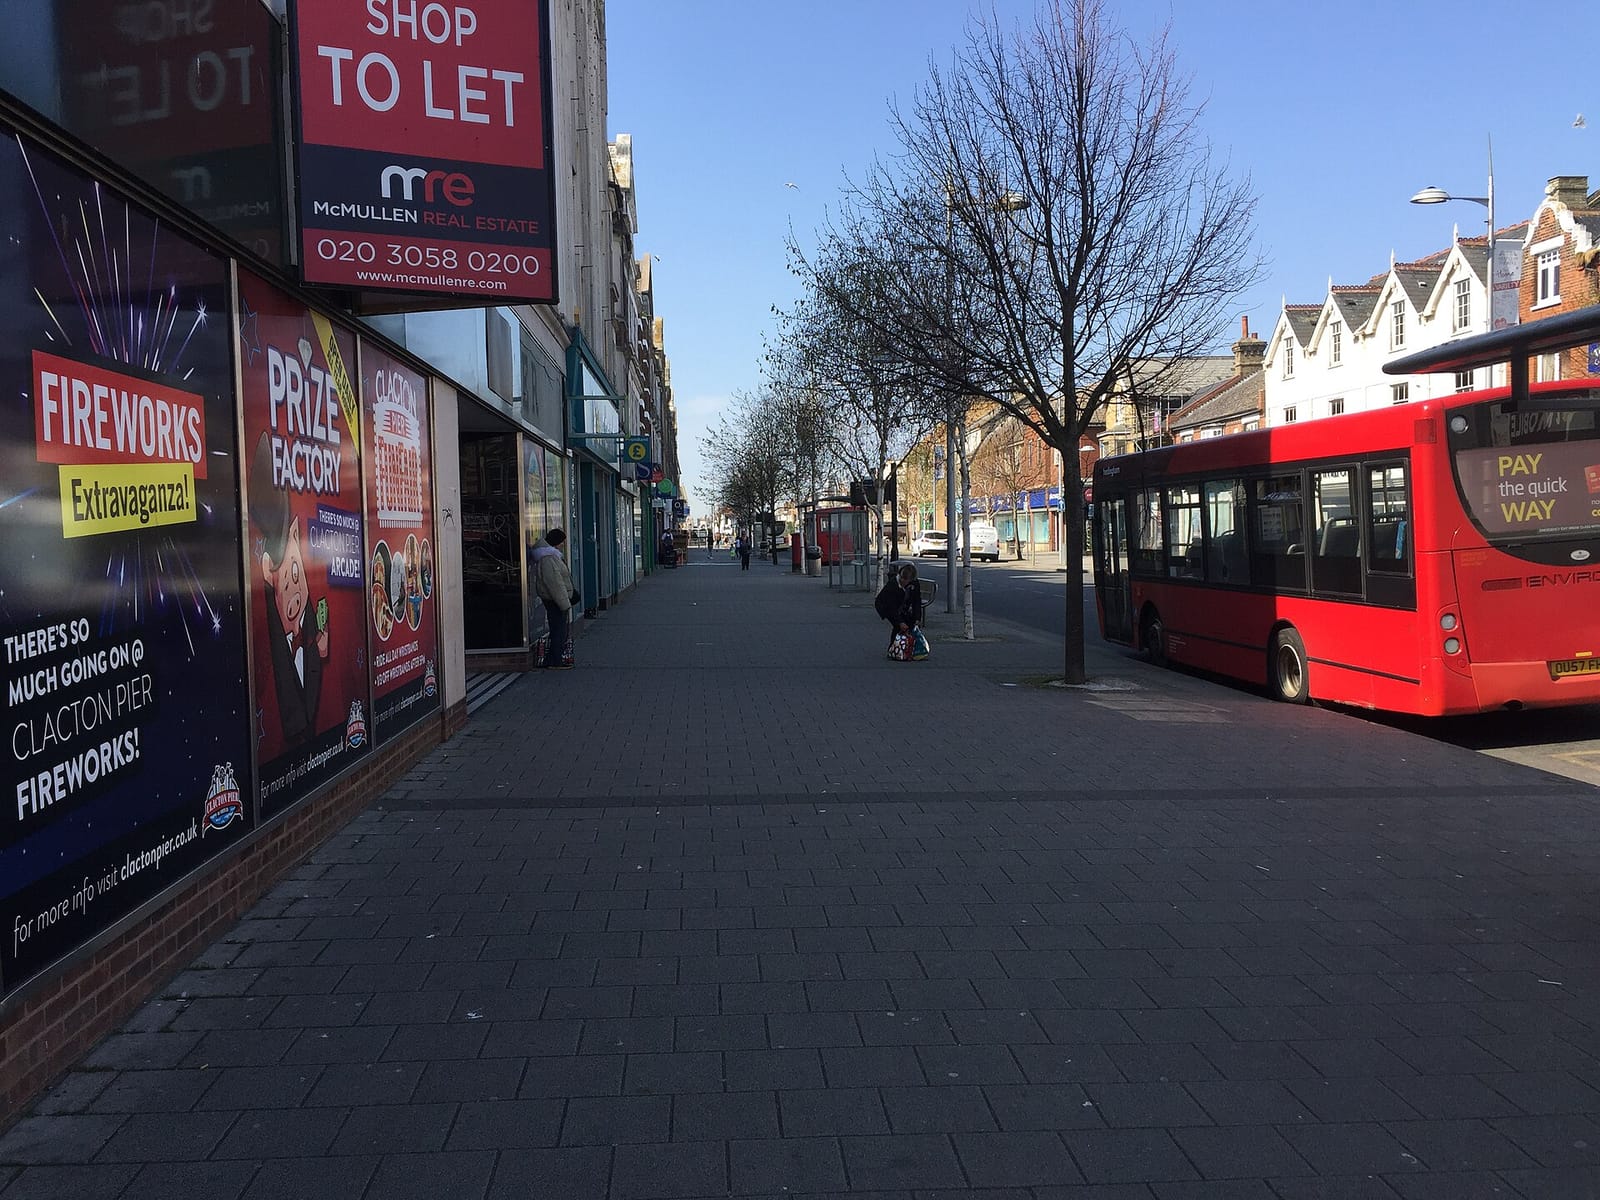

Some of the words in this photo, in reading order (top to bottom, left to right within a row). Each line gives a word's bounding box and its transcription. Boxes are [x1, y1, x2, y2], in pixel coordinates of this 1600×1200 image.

[366, 0, 478, 46] SHOP
[317, 45, 401, 112] TO
[423, 61, 524, 127] LET
[381, 165, 475, 206] mre
[313, 200, 418, 223] McMULLEN
[423, 211, 471, 228] REAL
[475, 216, 539, 234] ESTATE
[317, 238, 376, 263] 020
[386, 244, 458, 269] 3058
[467, 251, 540, 275] 0200
[356, 270, 507, 290] www.mcmullenre.com
[40, 370, 203, 463] FIREWORKS
[375, 369, 418, 420] CLACTON
[270, 437, 341, 494] FACTORY
[1498, 453, 1543, 477] PAY
[1498, 480, 1526, 497] the
[1528, 476, 1568, 498] quick
[71, 473, 190, 523] Extravaganza!
[1500, 499, 1556, 523] WAY
[331, 556, 360, 578] ARCADE!
[4, 623, 67, 664] THERE'S
[71, 617, 90, 642] SO
[9, 665, 57, 707] MUCH
[60, 650, 107, 687] GOING
[110, 644, 130, 670] ON
[131, 639, 145, 669] @
[12, 692, 113, 761] CLACTON
[116, 673, 153, 717] PIER
[16, 728, 140, 821] FIREWORKS!
[13, 915, 34, 958] for
[36, 898, 69, 933] more
[72, 876, 95, 915] info
[96, 863, 119, 896] visit
[120, 816, 198, 881] clactonpier.co.uk
